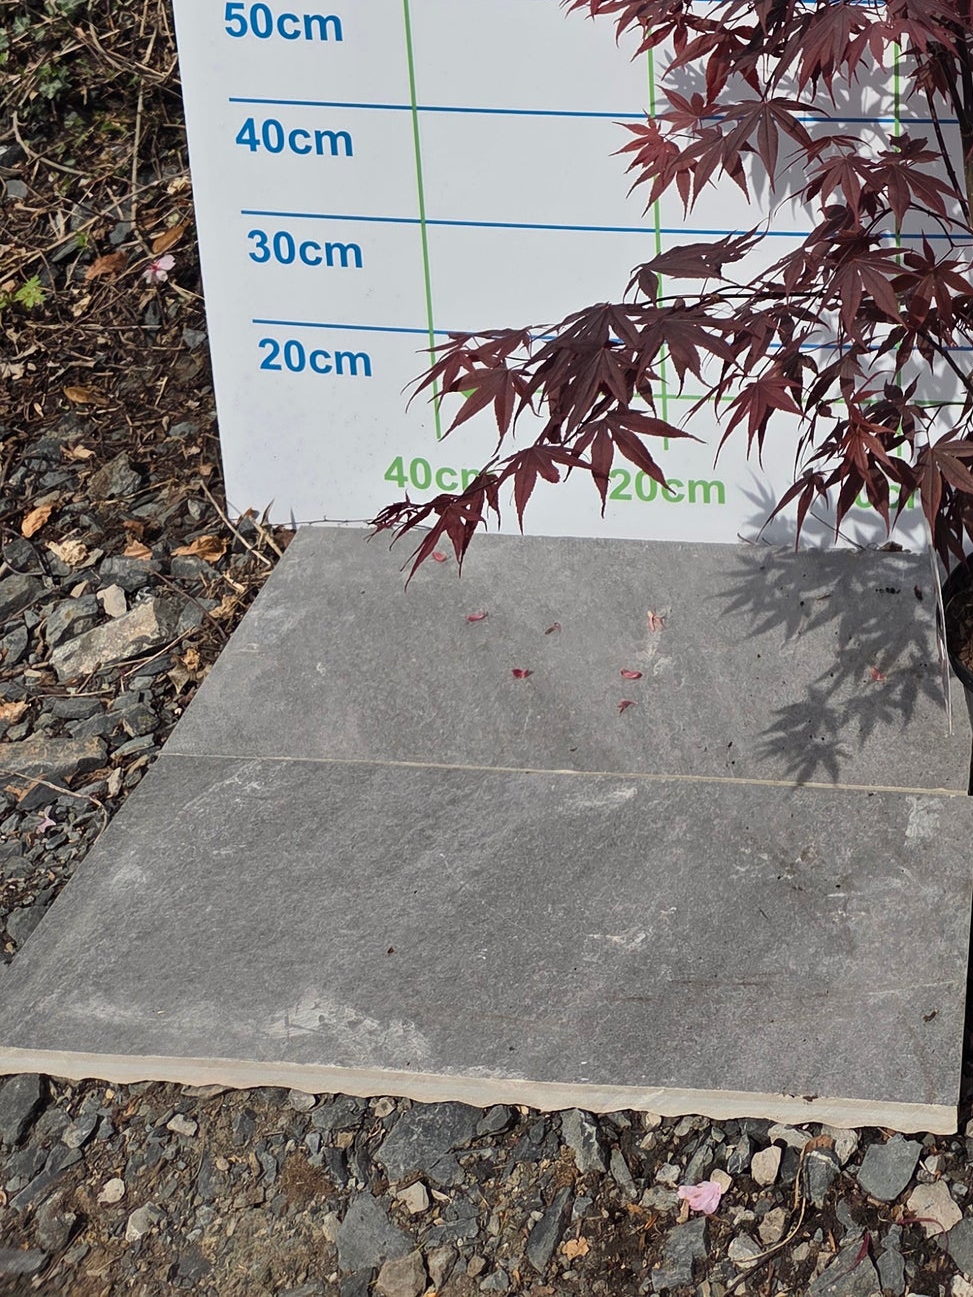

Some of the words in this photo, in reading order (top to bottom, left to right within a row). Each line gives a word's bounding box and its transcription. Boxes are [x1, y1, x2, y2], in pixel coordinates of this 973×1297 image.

[225, 2, 343, 41] 50cm
[236, 118, 353, 157] 40cm
[248, 229, 363, 268] 30cm
[259, 338, 372, 377] 20cm
[609, 468, 726, 504] 20cm
